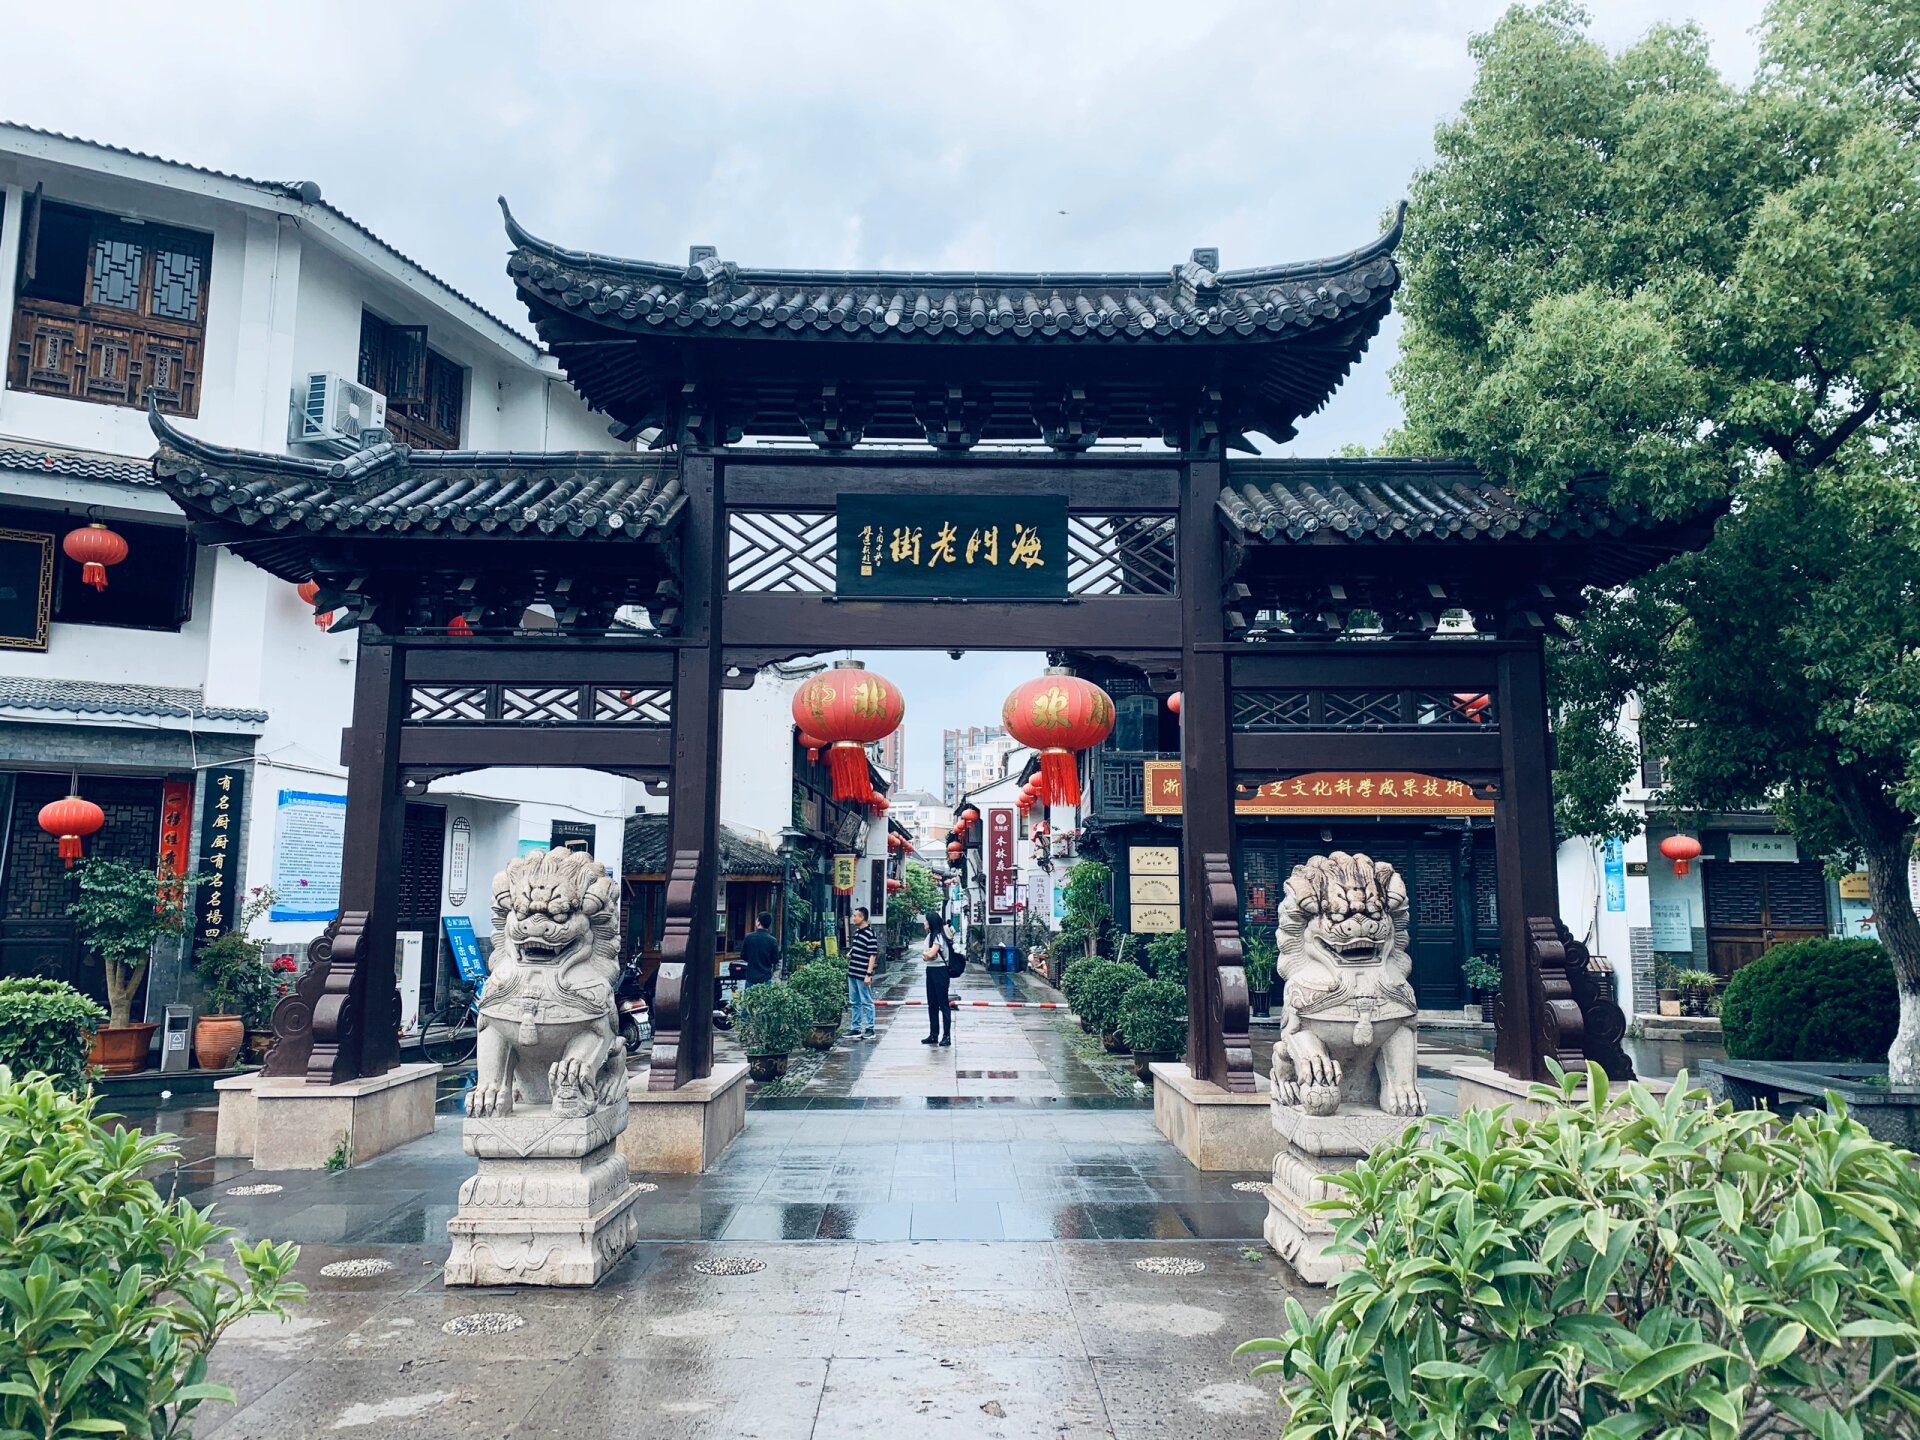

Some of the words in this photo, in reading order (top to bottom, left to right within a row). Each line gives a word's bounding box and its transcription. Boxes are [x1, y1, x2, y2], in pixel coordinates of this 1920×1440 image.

[1032, 687, 1072, 730] 欢
[995, 835, 1008, 872] 木林森
